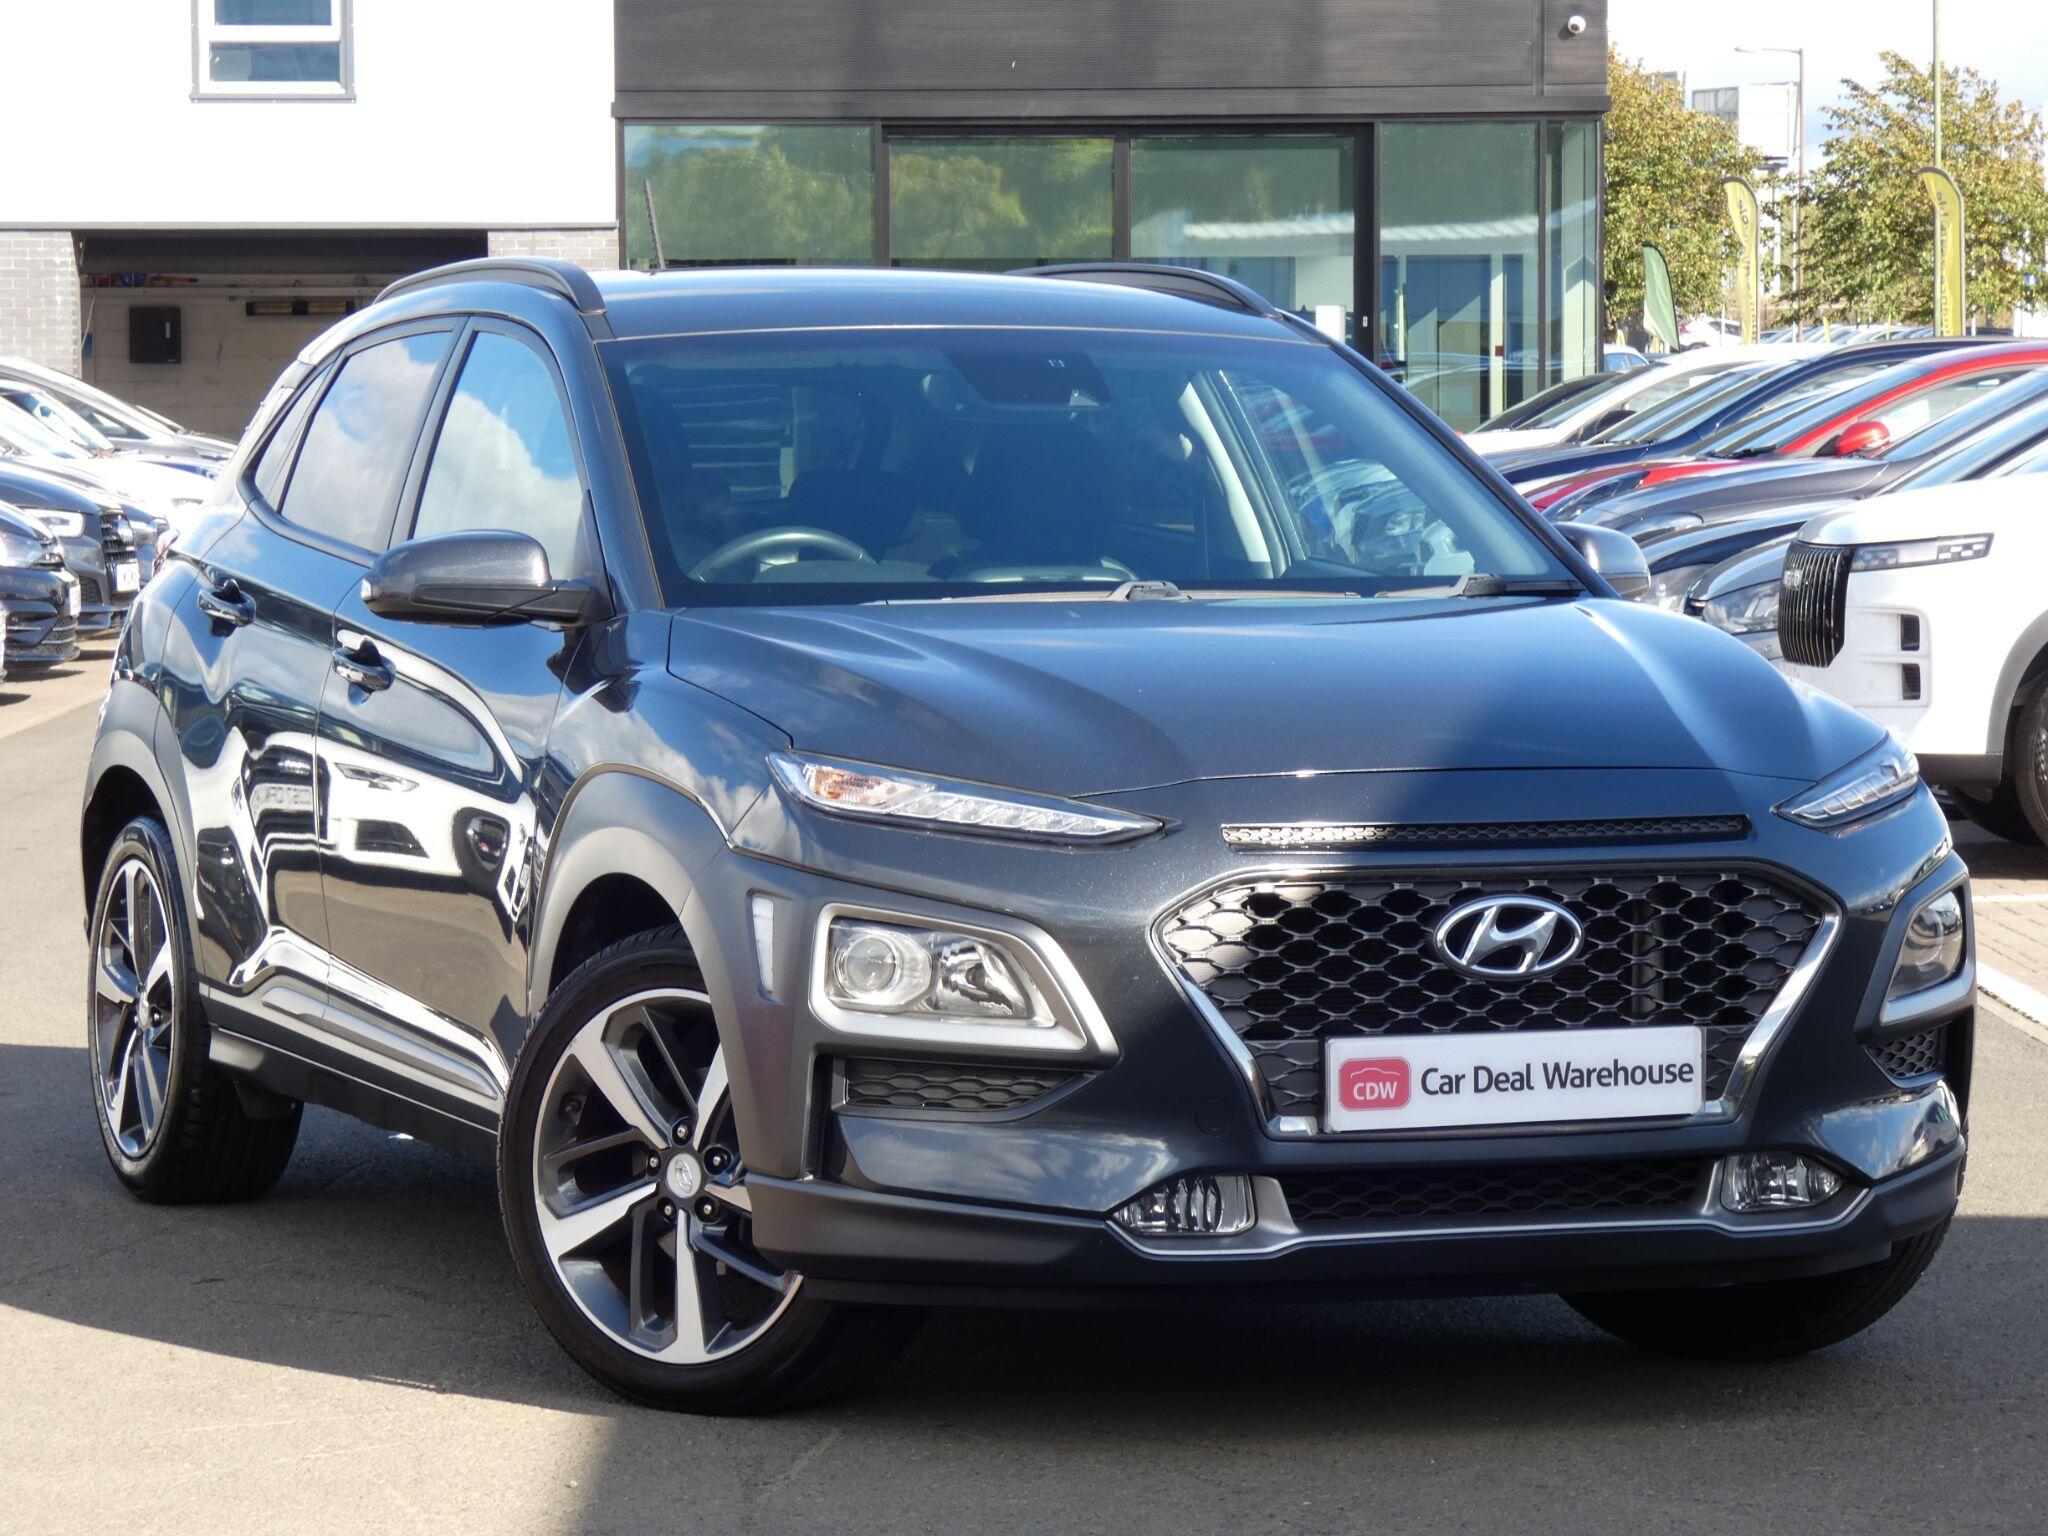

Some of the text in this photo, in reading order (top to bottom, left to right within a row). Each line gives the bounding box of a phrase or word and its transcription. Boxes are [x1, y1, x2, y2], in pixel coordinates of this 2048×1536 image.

[1352, 1081, 1398, 1101] CDW
[1420, 1059, 1694, 1096] Car Deal Warehouse
